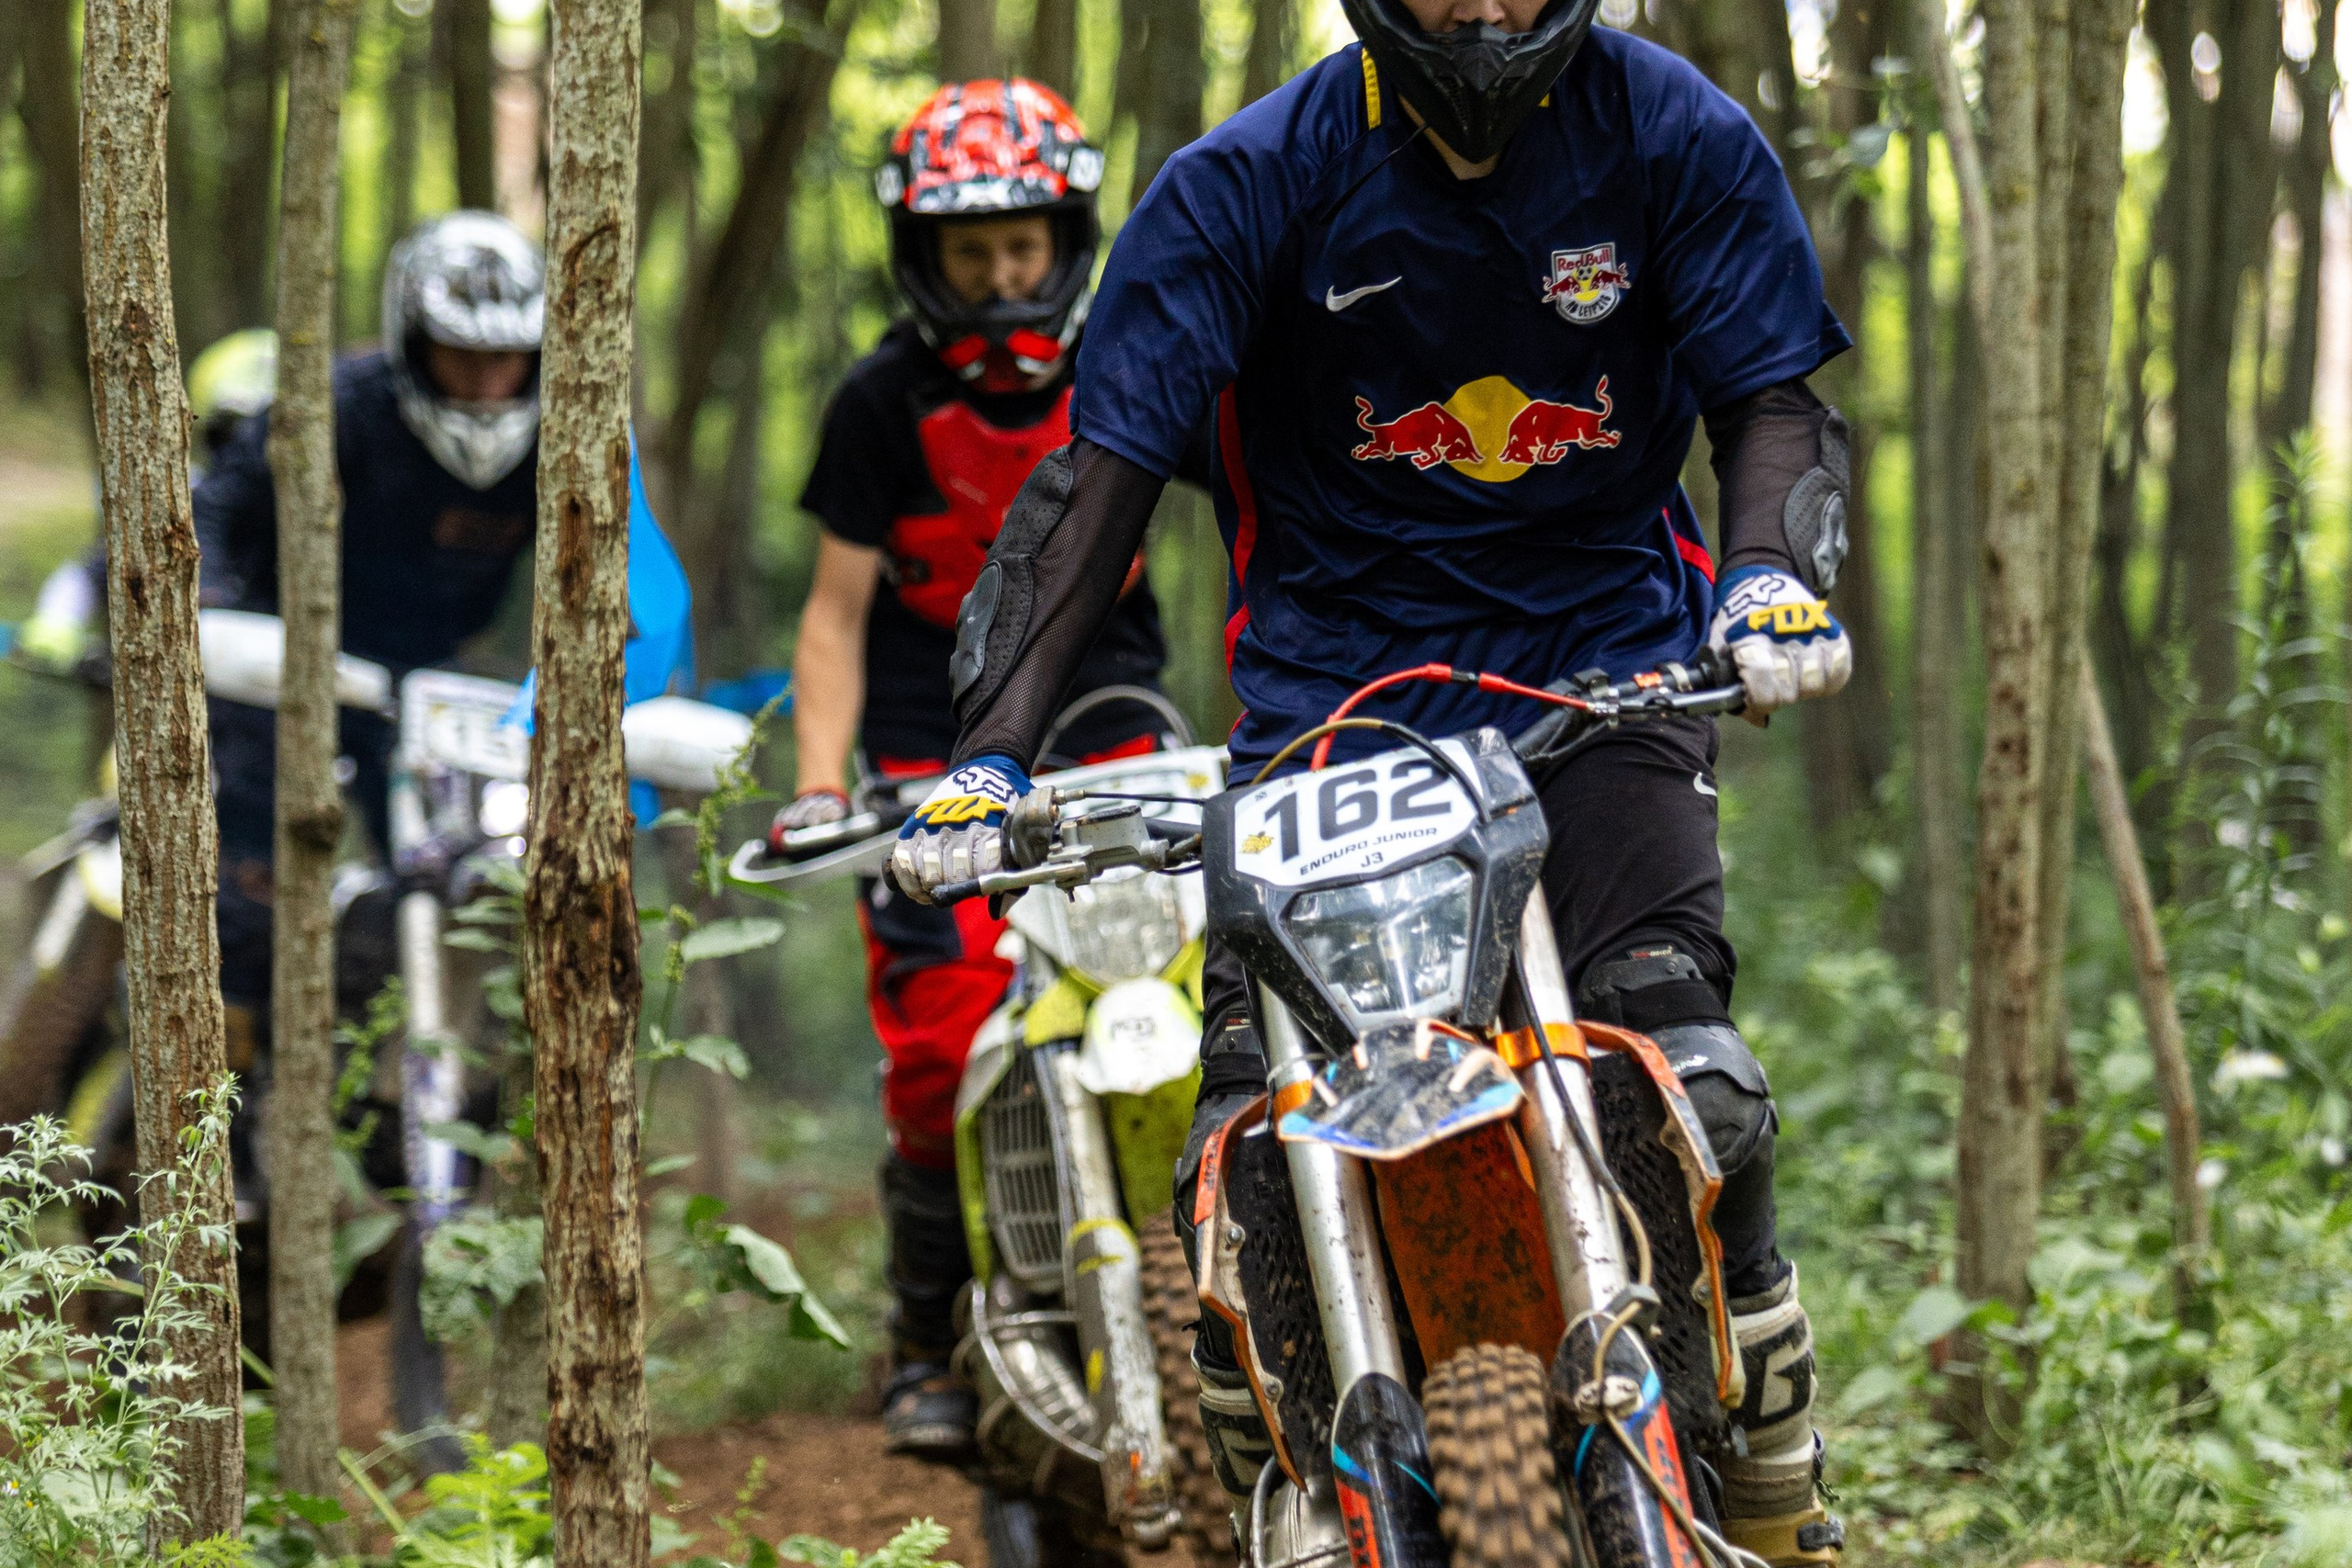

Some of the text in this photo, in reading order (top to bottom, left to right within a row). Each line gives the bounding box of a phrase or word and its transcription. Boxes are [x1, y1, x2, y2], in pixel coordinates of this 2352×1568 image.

[1557, 249, 1610, 271] Red Bull
[1747, 600, 1831, 635] FOX
[915, 795, 1007, 825] FOX
[1264, 758, 1452, 863] 162
[1300, 828, 1438, 875] ENDURO JUNIOR
[1361, 852, 1384, 868] J3
